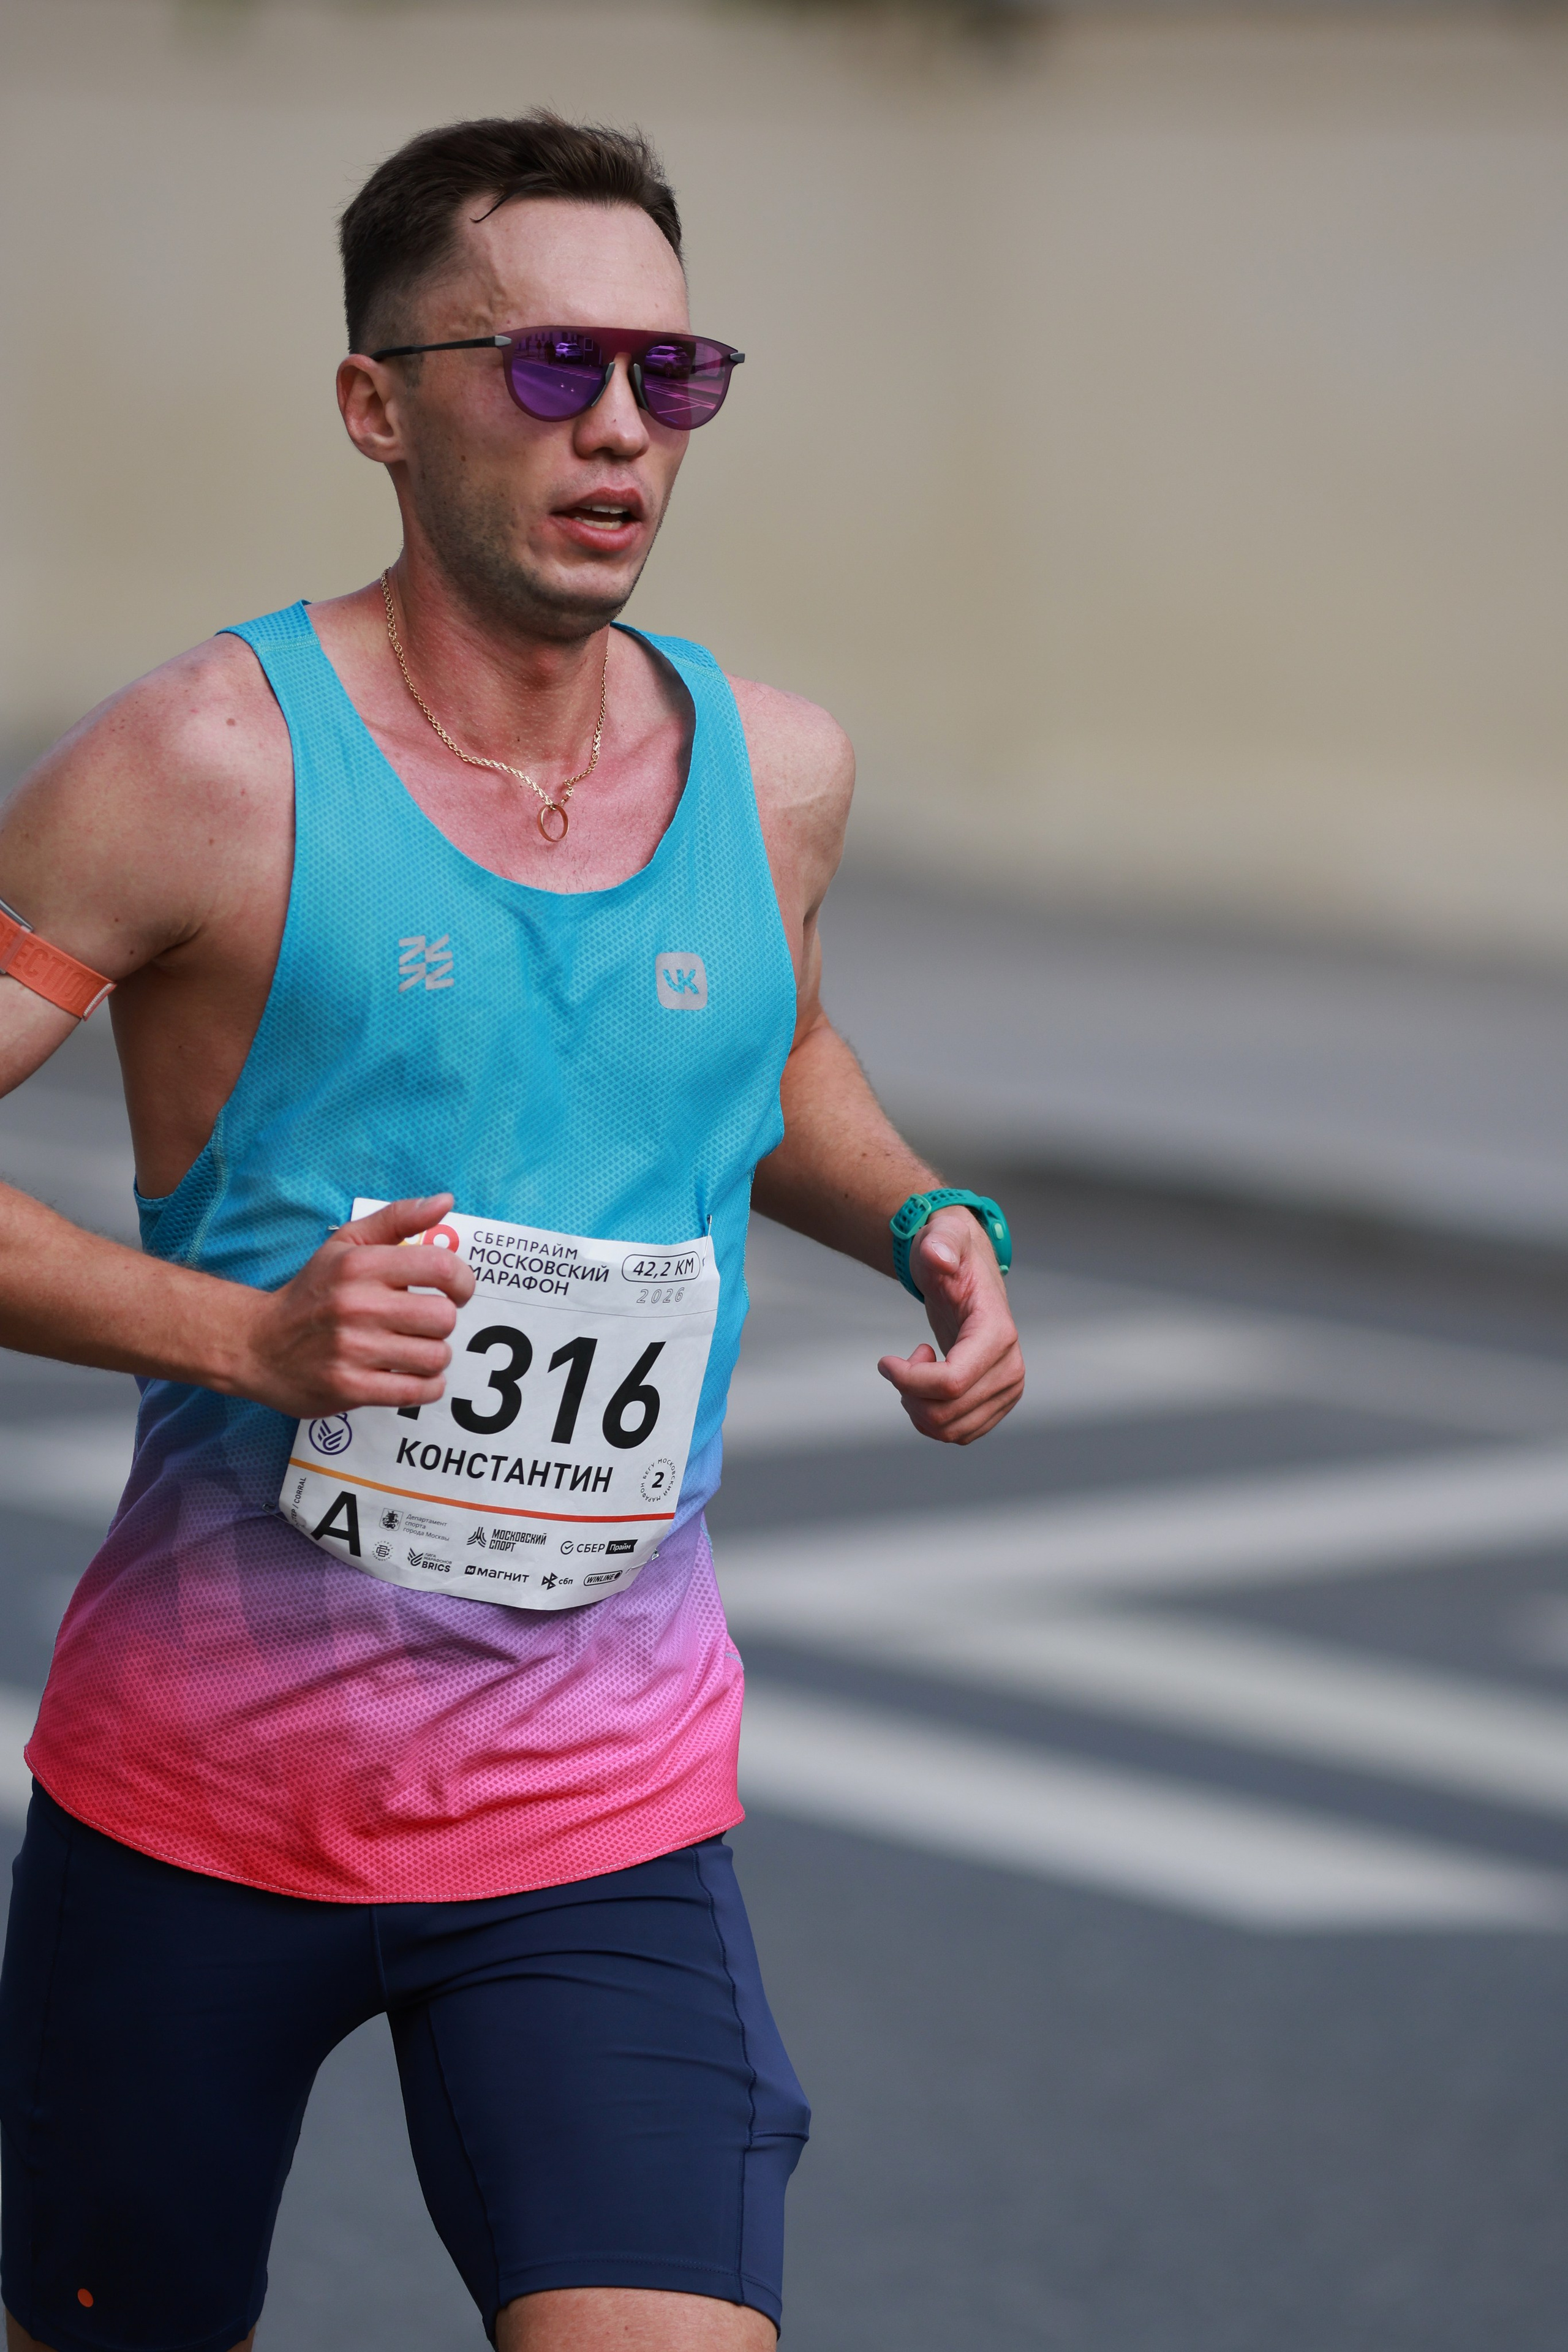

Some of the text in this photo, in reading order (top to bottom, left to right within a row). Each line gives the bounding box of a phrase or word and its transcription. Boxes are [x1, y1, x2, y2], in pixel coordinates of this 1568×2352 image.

[662, 969, 699, 995] VK
[473, 1231, 578, 1260] СБЕРПРАЙМ
[469, 1246, 609, 1283] МОСКОВСКИЙ
[633, 1261, 671, 1279] 42,2
[636, 1287, 685, 1303] 2026
[397, 1325, 666, 1449] 316
[396, 1437, 614, 1493] КОНСТАНТИН
[651, 1471, 665, 1488] 2
[293, 1477, 306, 1504] CORRAL
[405, 1513, 448, 1527] Департамент
[405, 1520, 426, 1529] спорта
[403, 1527, 450, 1542] города Москвы
[491, 1528, 547, 1545] МОСКОВСКИЙ
[489, 1539, 516, 1552] СПОРТ
[576, 1542, 631, 1553] СБЕР Прайм
[421, 1561, 451, 1573] BRICS
[586, 1574, 615, 1584] WINLINE
